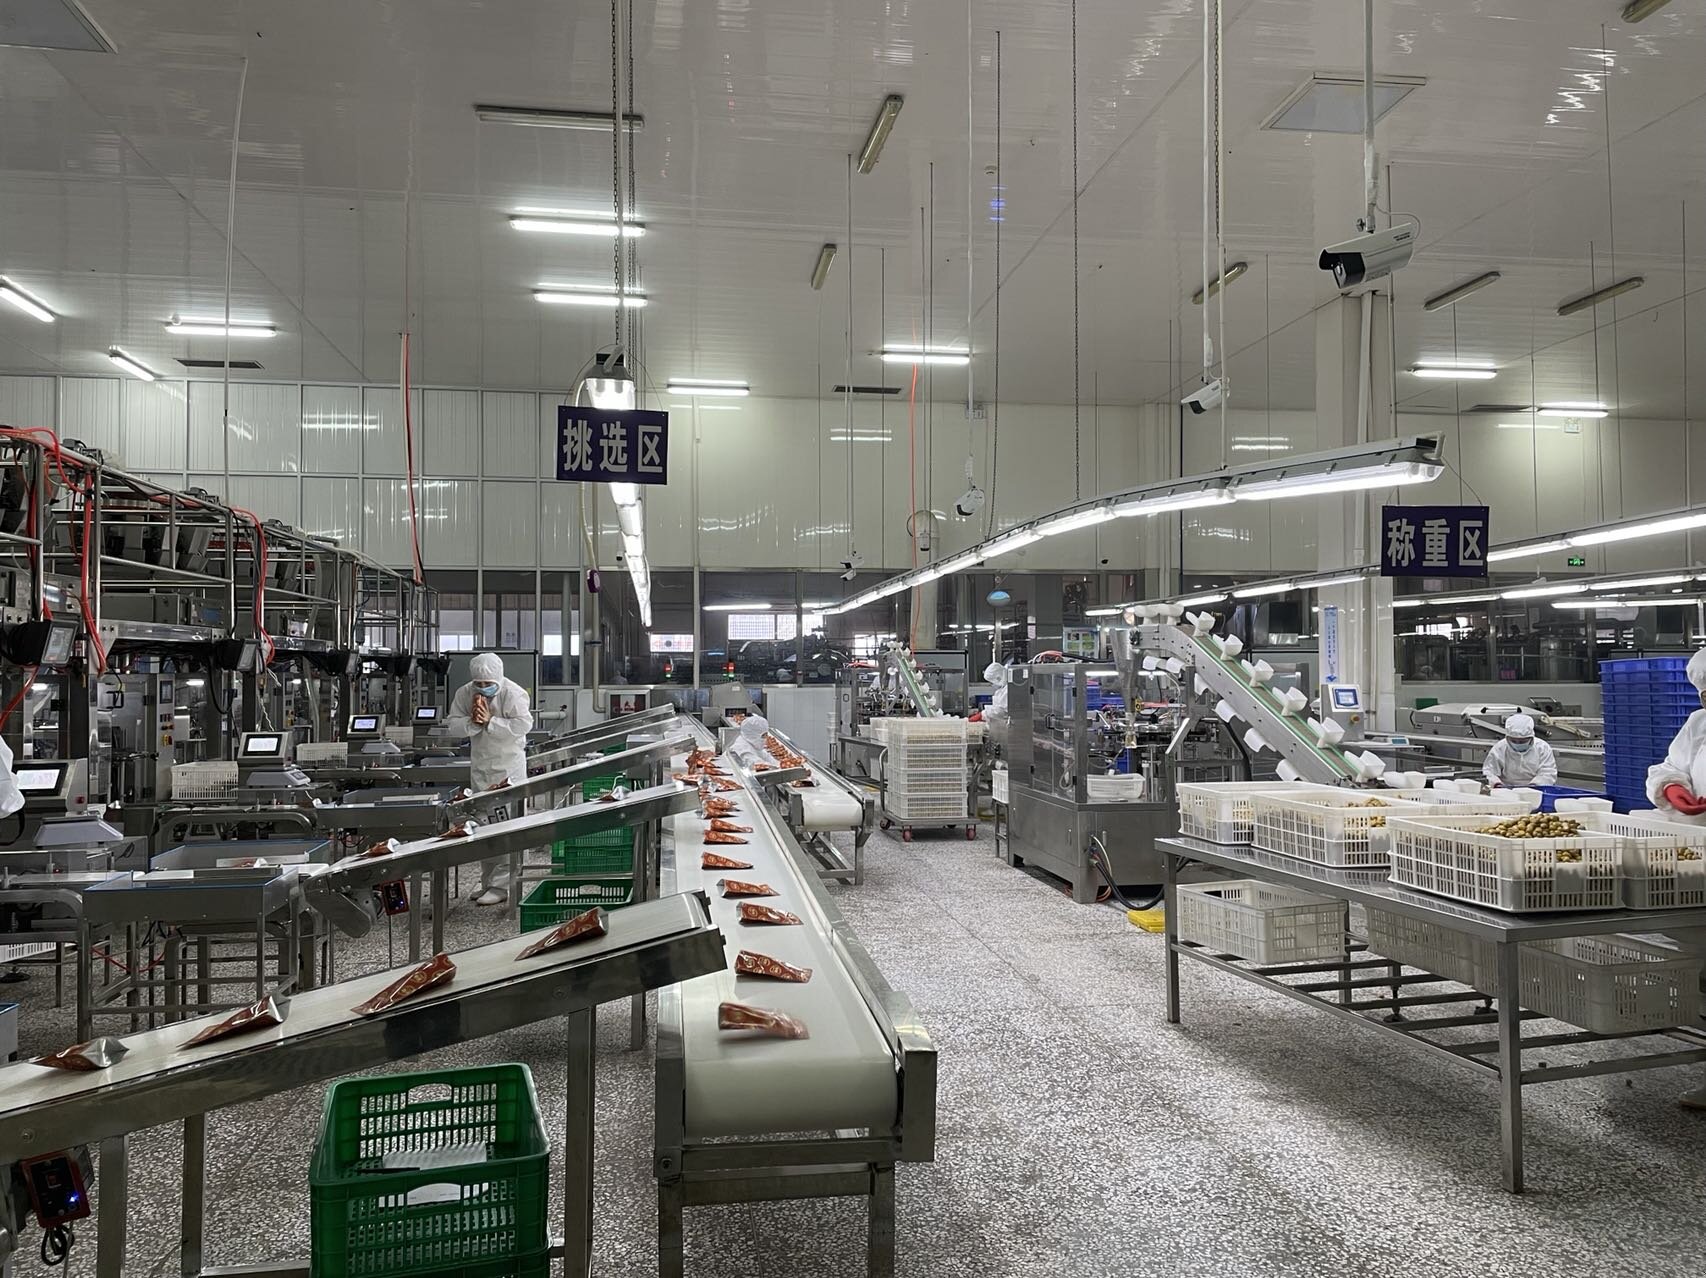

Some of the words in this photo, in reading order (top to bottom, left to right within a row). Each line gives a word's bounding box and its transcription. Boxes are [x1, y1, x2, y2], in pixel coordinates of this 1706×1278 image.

[563, 419, 663, 472] 挑选区
[1387, 518, 1483, 567] 称重区
